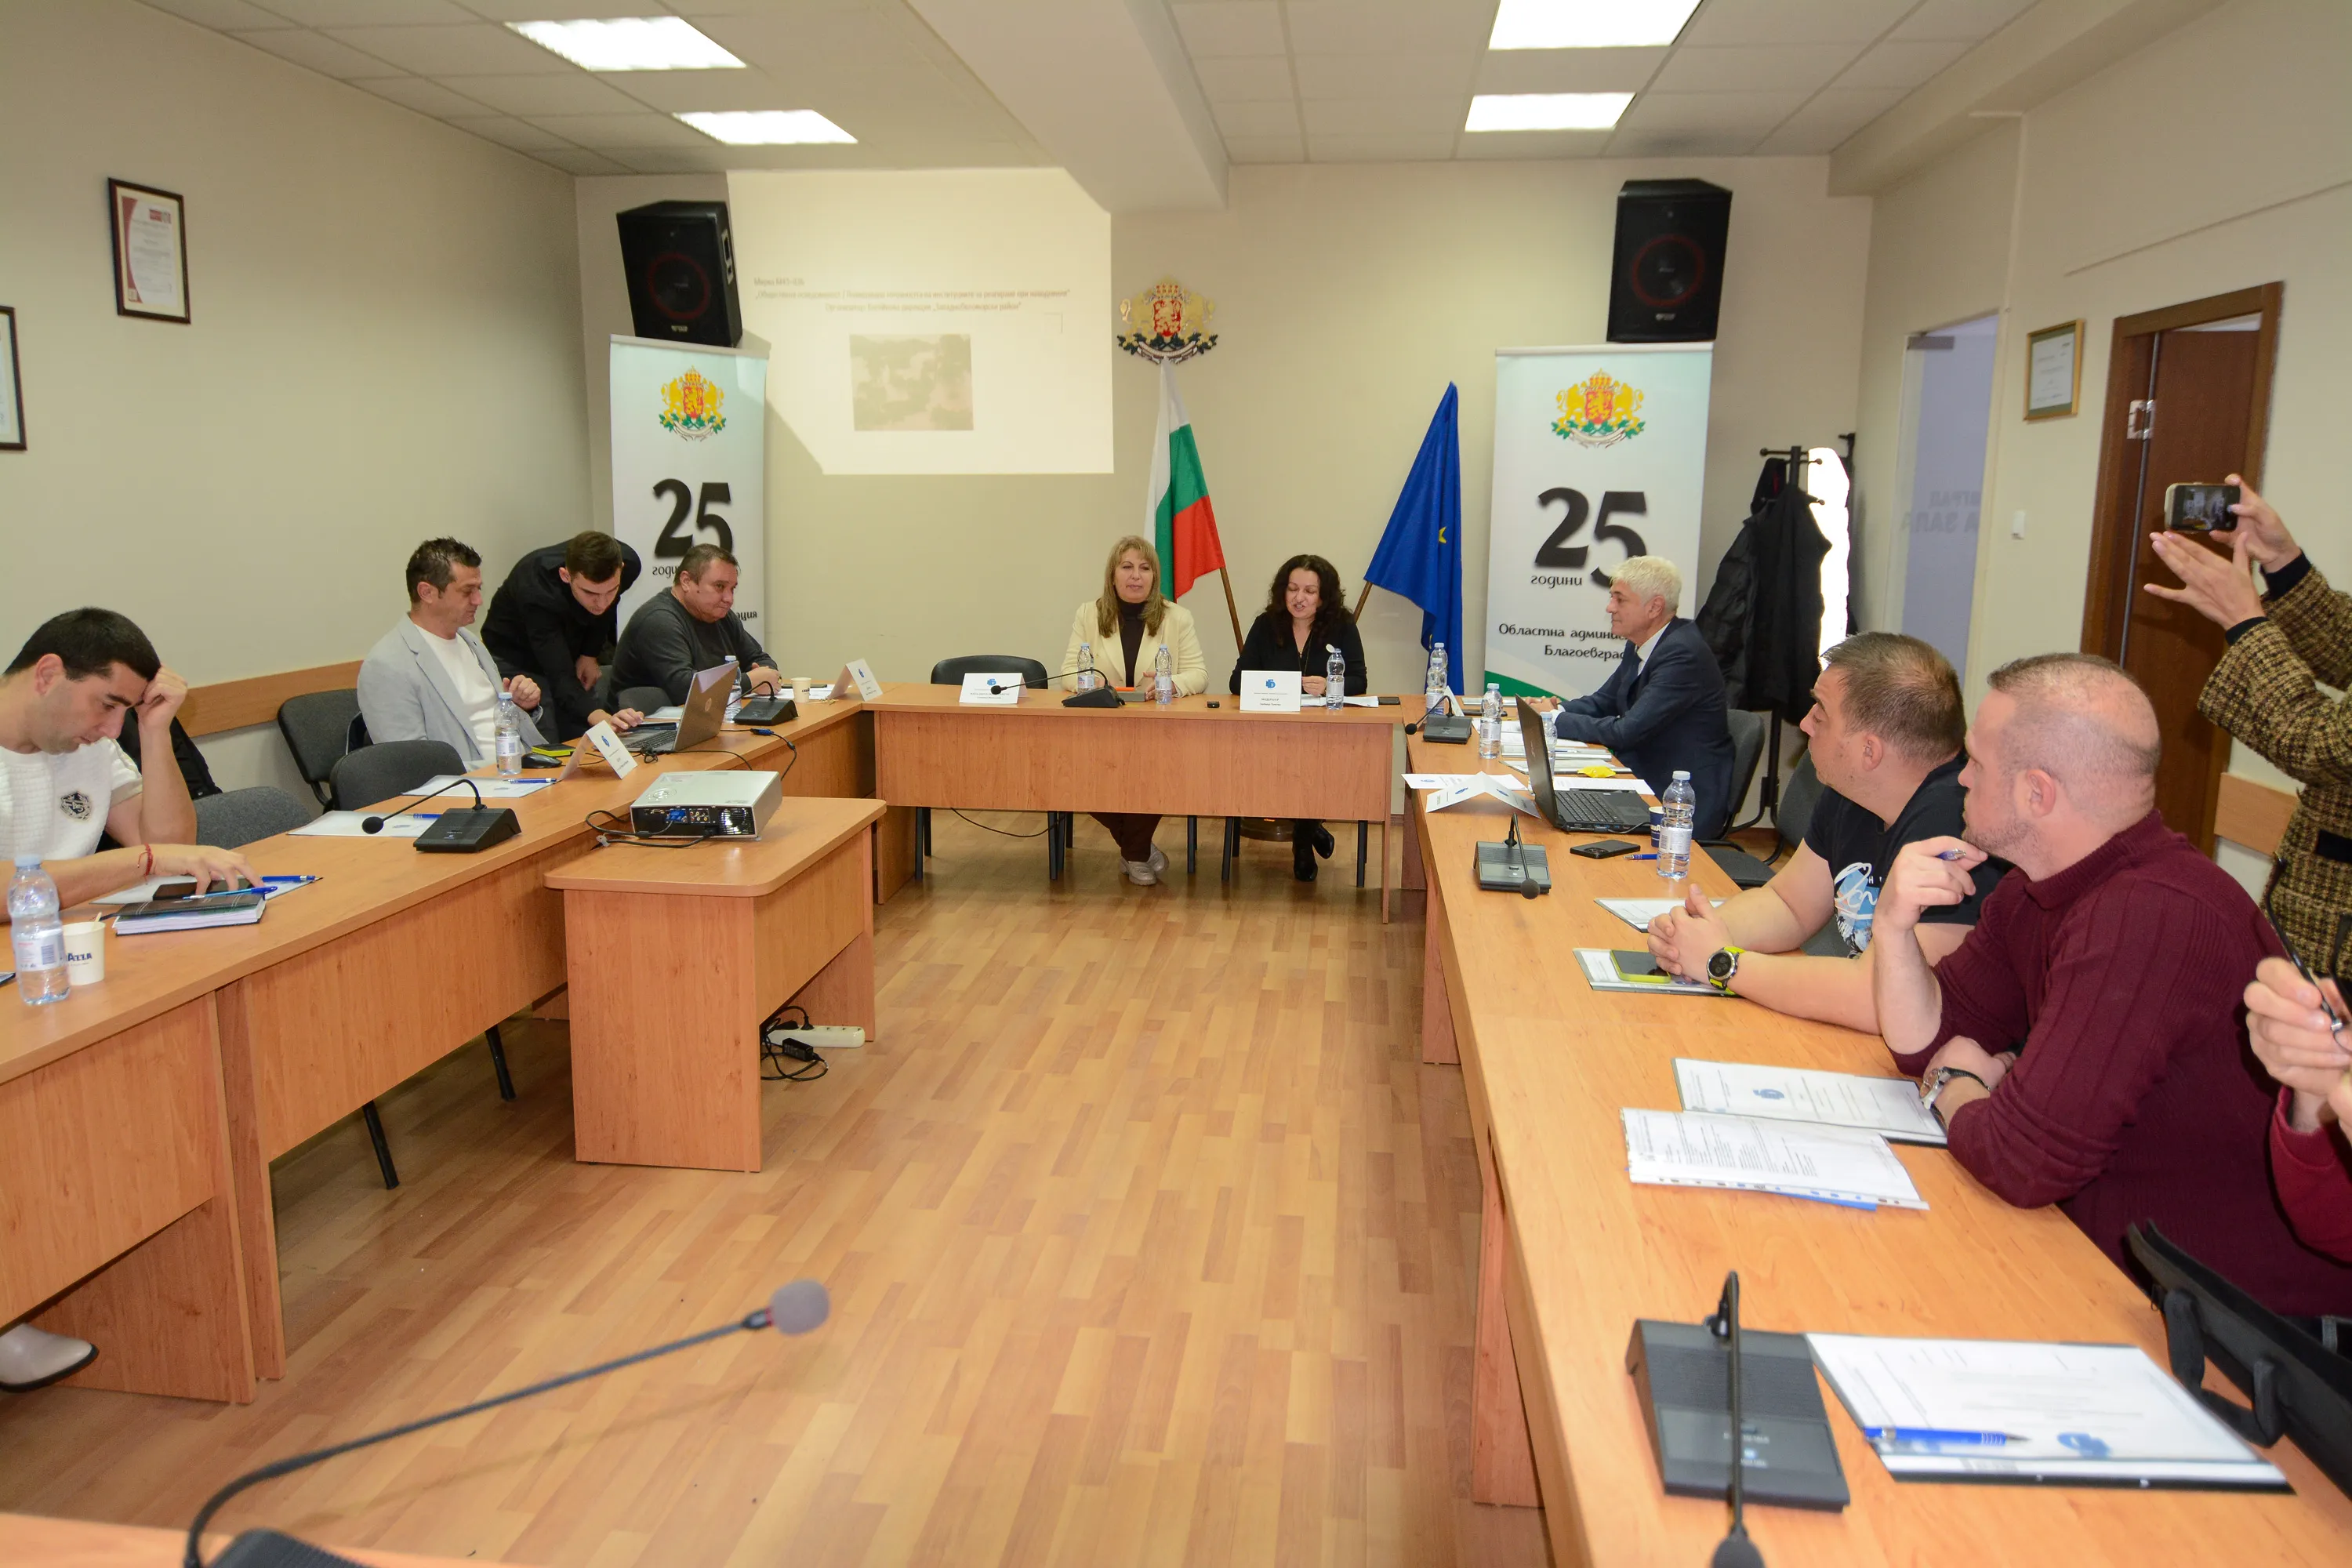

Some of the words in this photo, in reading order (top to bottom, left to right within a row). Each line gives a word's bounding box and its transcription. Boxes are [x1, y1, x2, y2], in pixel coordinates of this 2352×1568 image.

[652, 478, 733, 559] 25
[1534, 487, 1647, 589] 25
[1530, 575, 1583, 589] години
[1498, 623, 1565, 637] Областна
[67, 953, 93, 962] AZZA
